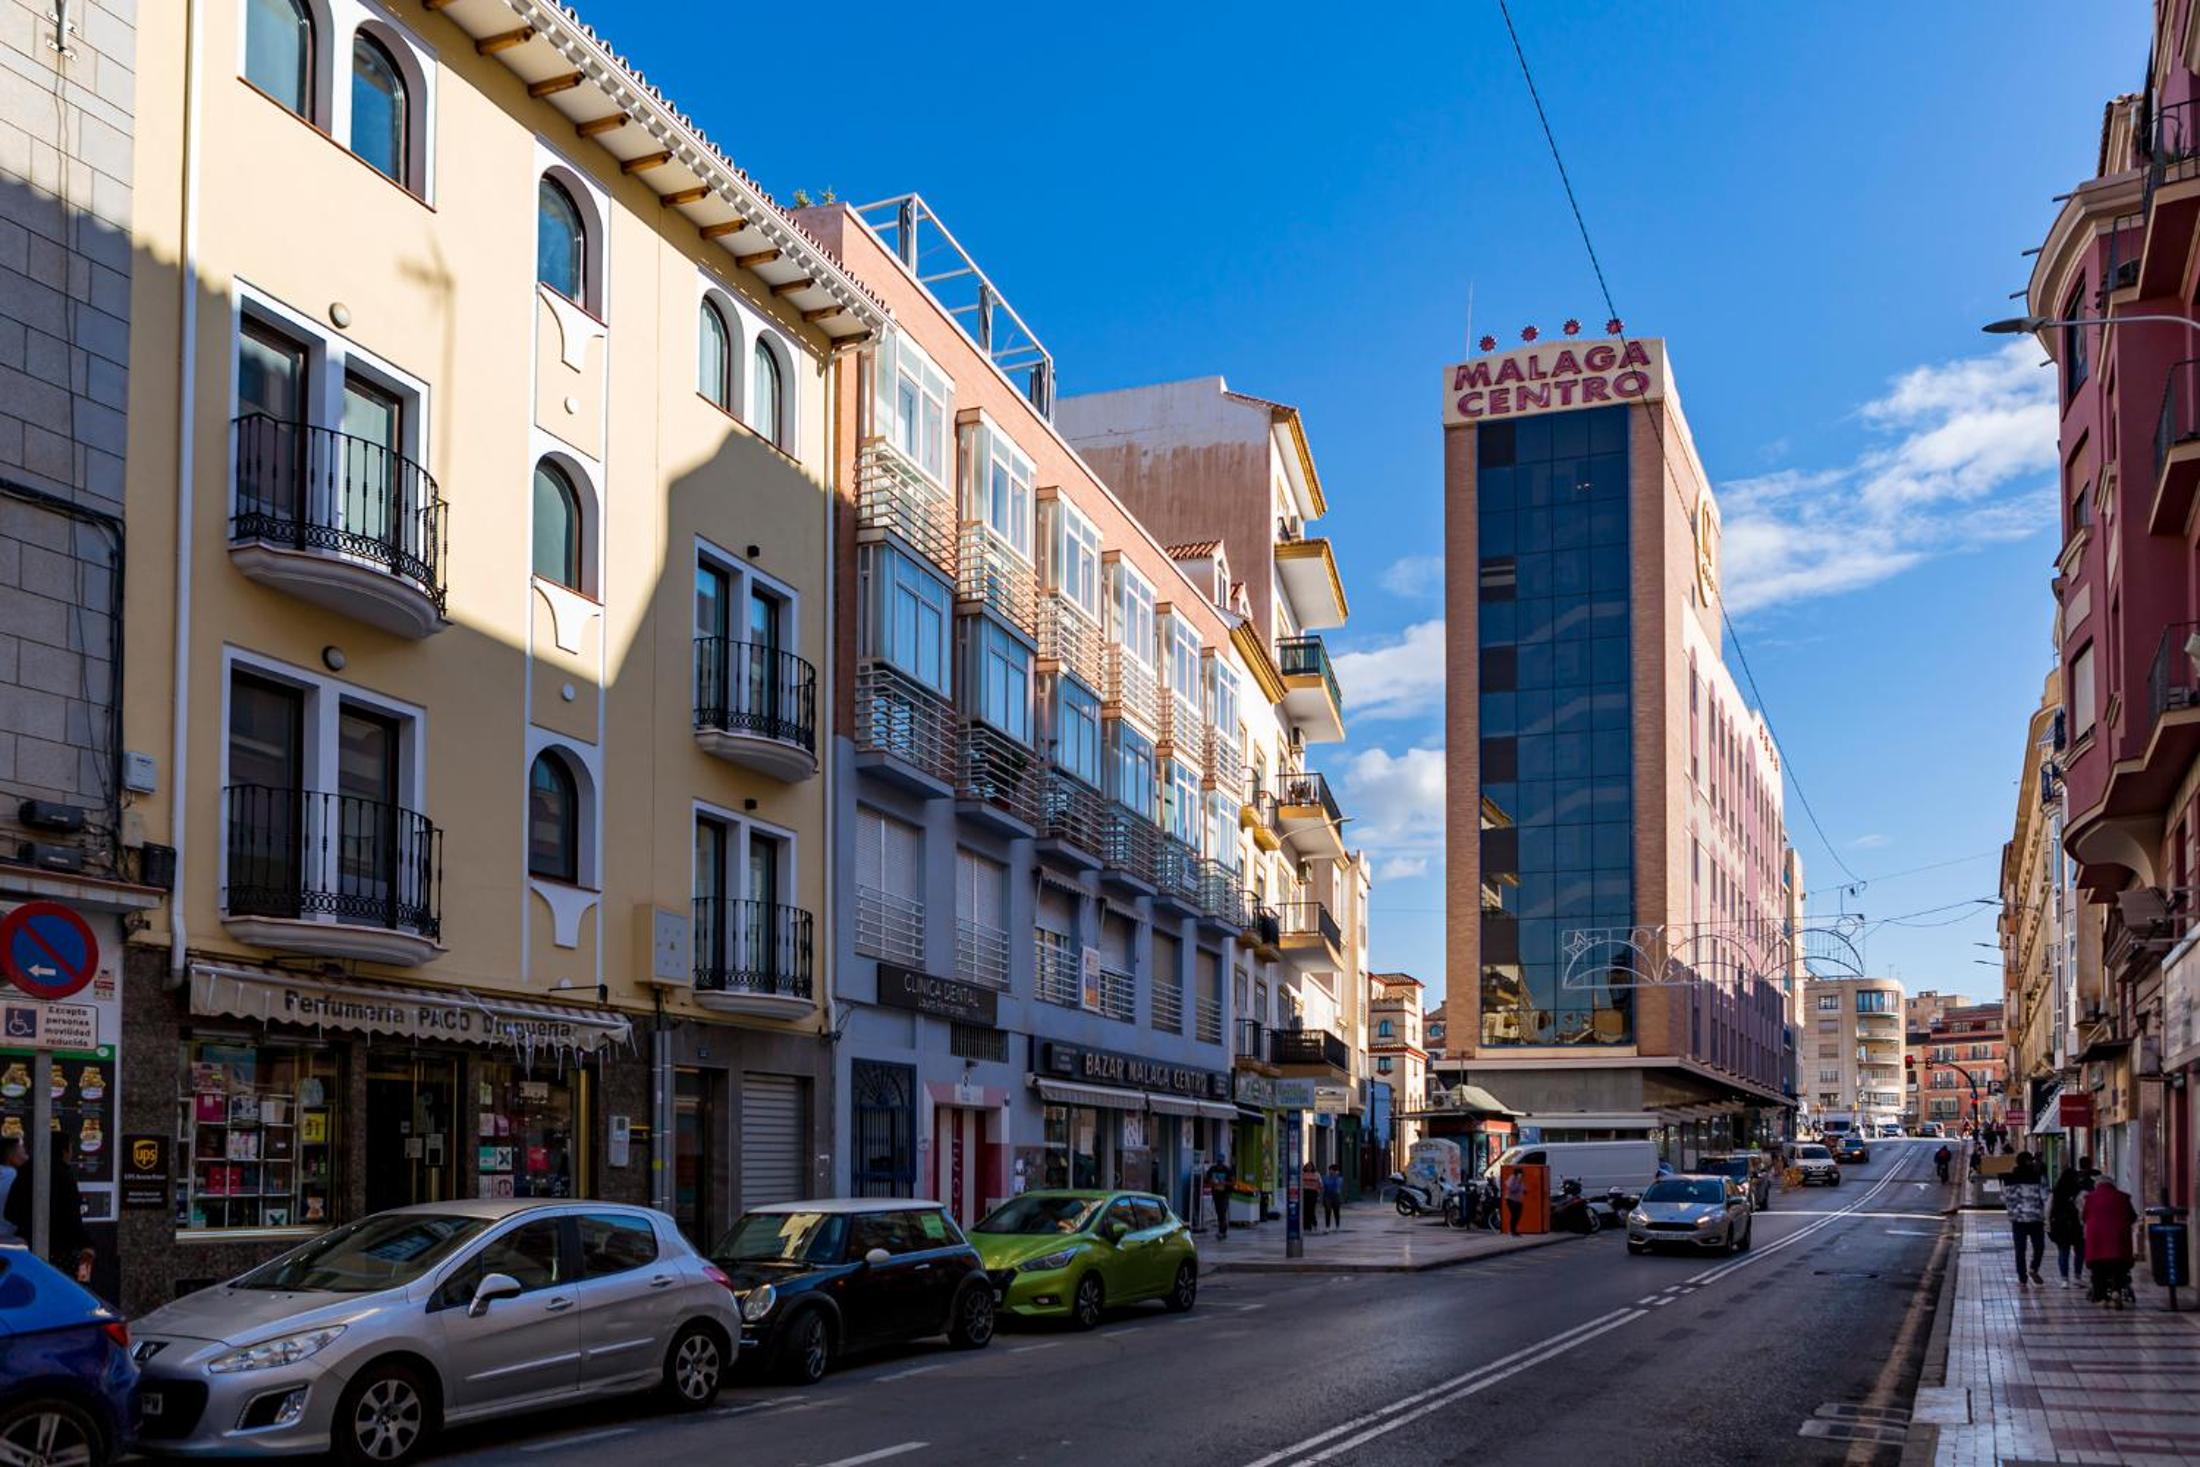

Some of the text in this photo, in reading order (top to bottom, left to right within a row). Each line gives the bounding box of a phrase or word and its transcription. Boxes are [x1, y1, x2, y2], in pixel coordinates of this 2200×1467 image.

[1454, 340, 1652, 391] MALAGA
[1457, 370, 1651, 418] CENTRO
[418, 1007, 470, 1031] PACO
[1085, 1052, 1125, 1081] BAZAR
[1129, 1061, 1170, 1088] MALAGA
[1173, 1068, 1207, 1094] CENTRO
